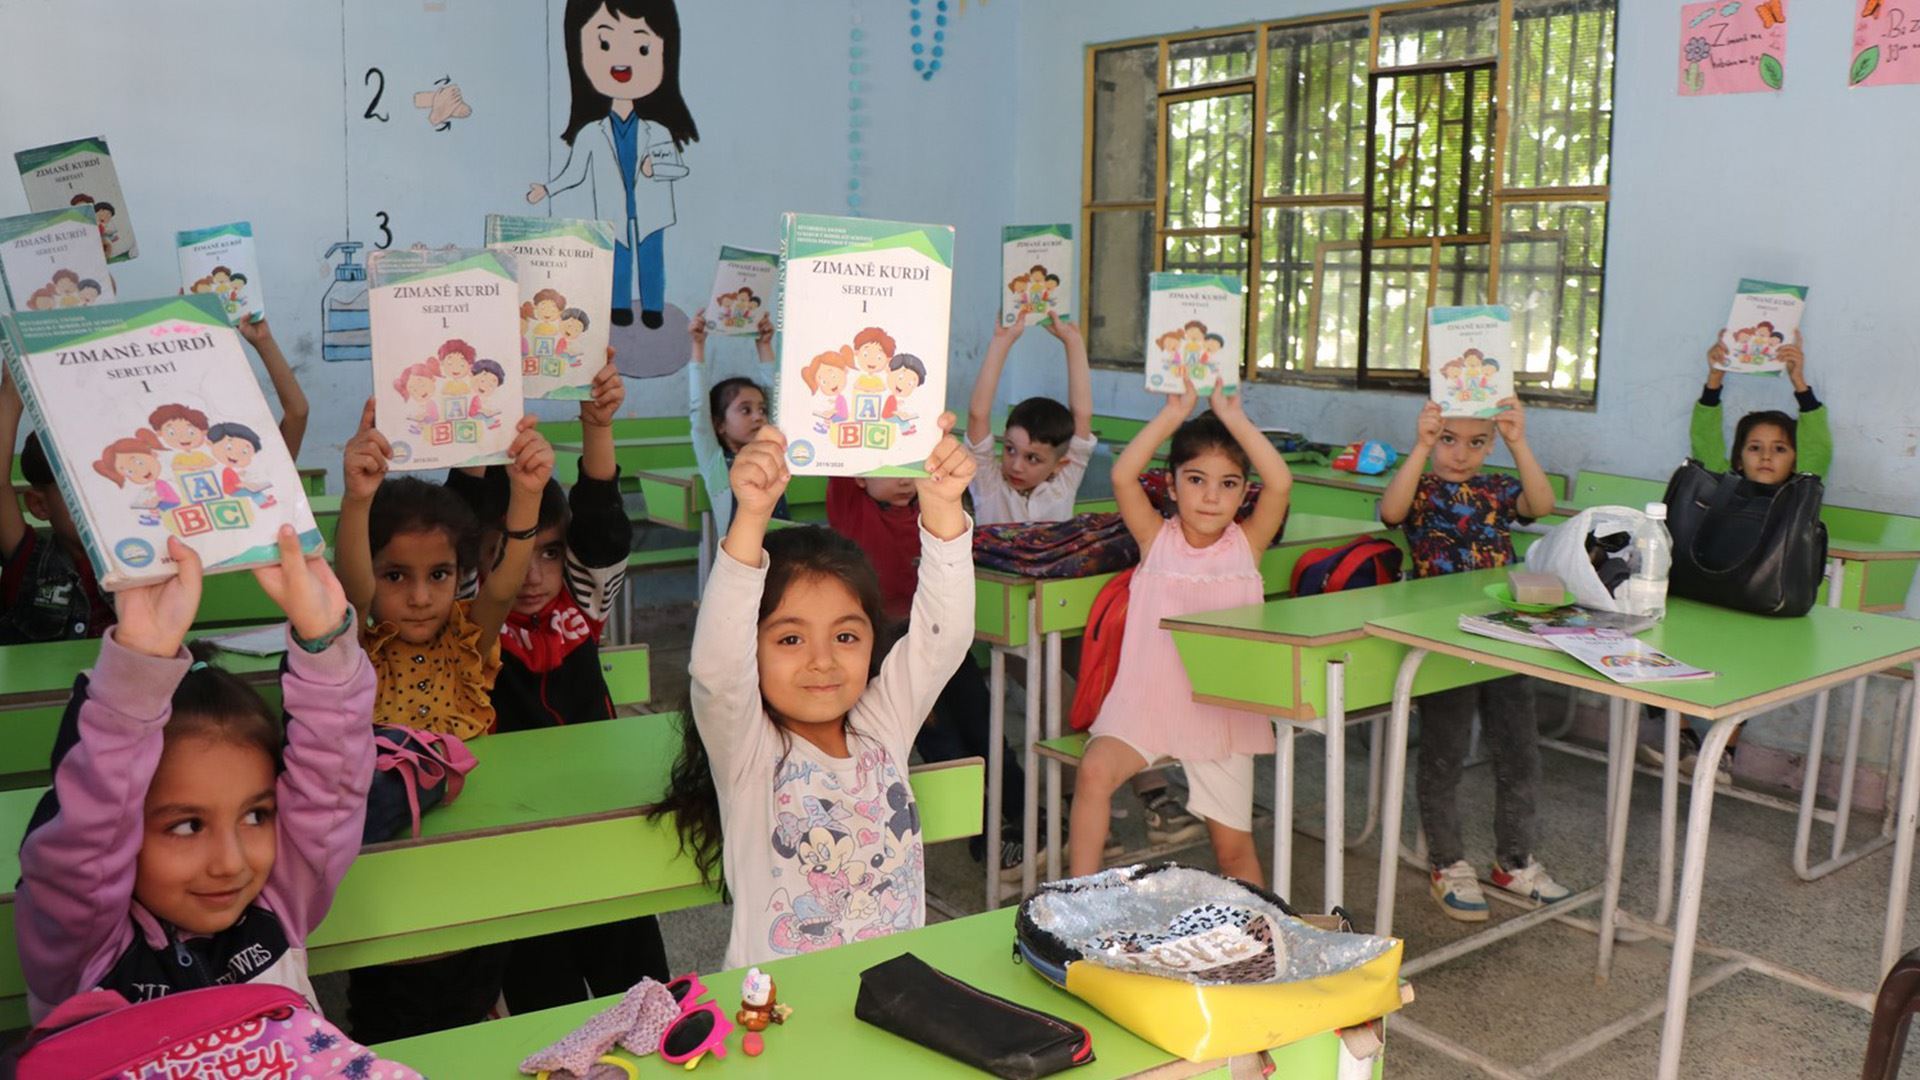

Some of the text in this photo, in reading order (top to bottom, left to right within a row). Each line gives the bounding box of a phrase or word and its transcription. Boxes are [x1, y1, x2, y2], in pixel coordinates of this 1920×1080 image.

[363, 67, 390, 123] 2
[374, 211, 394, 250] 3
[812, 259, 930, 281] ZIMANÊ KURDÎ
[393, 282, 500, 298] ZIMANÊ KURDÎ
[841, 284, 894, 297] SERETAYÎ
[57, 334, 217, 367] ZIMANÊ KURDÎ
[106, 361, 178, 380] SERETAYÎ
